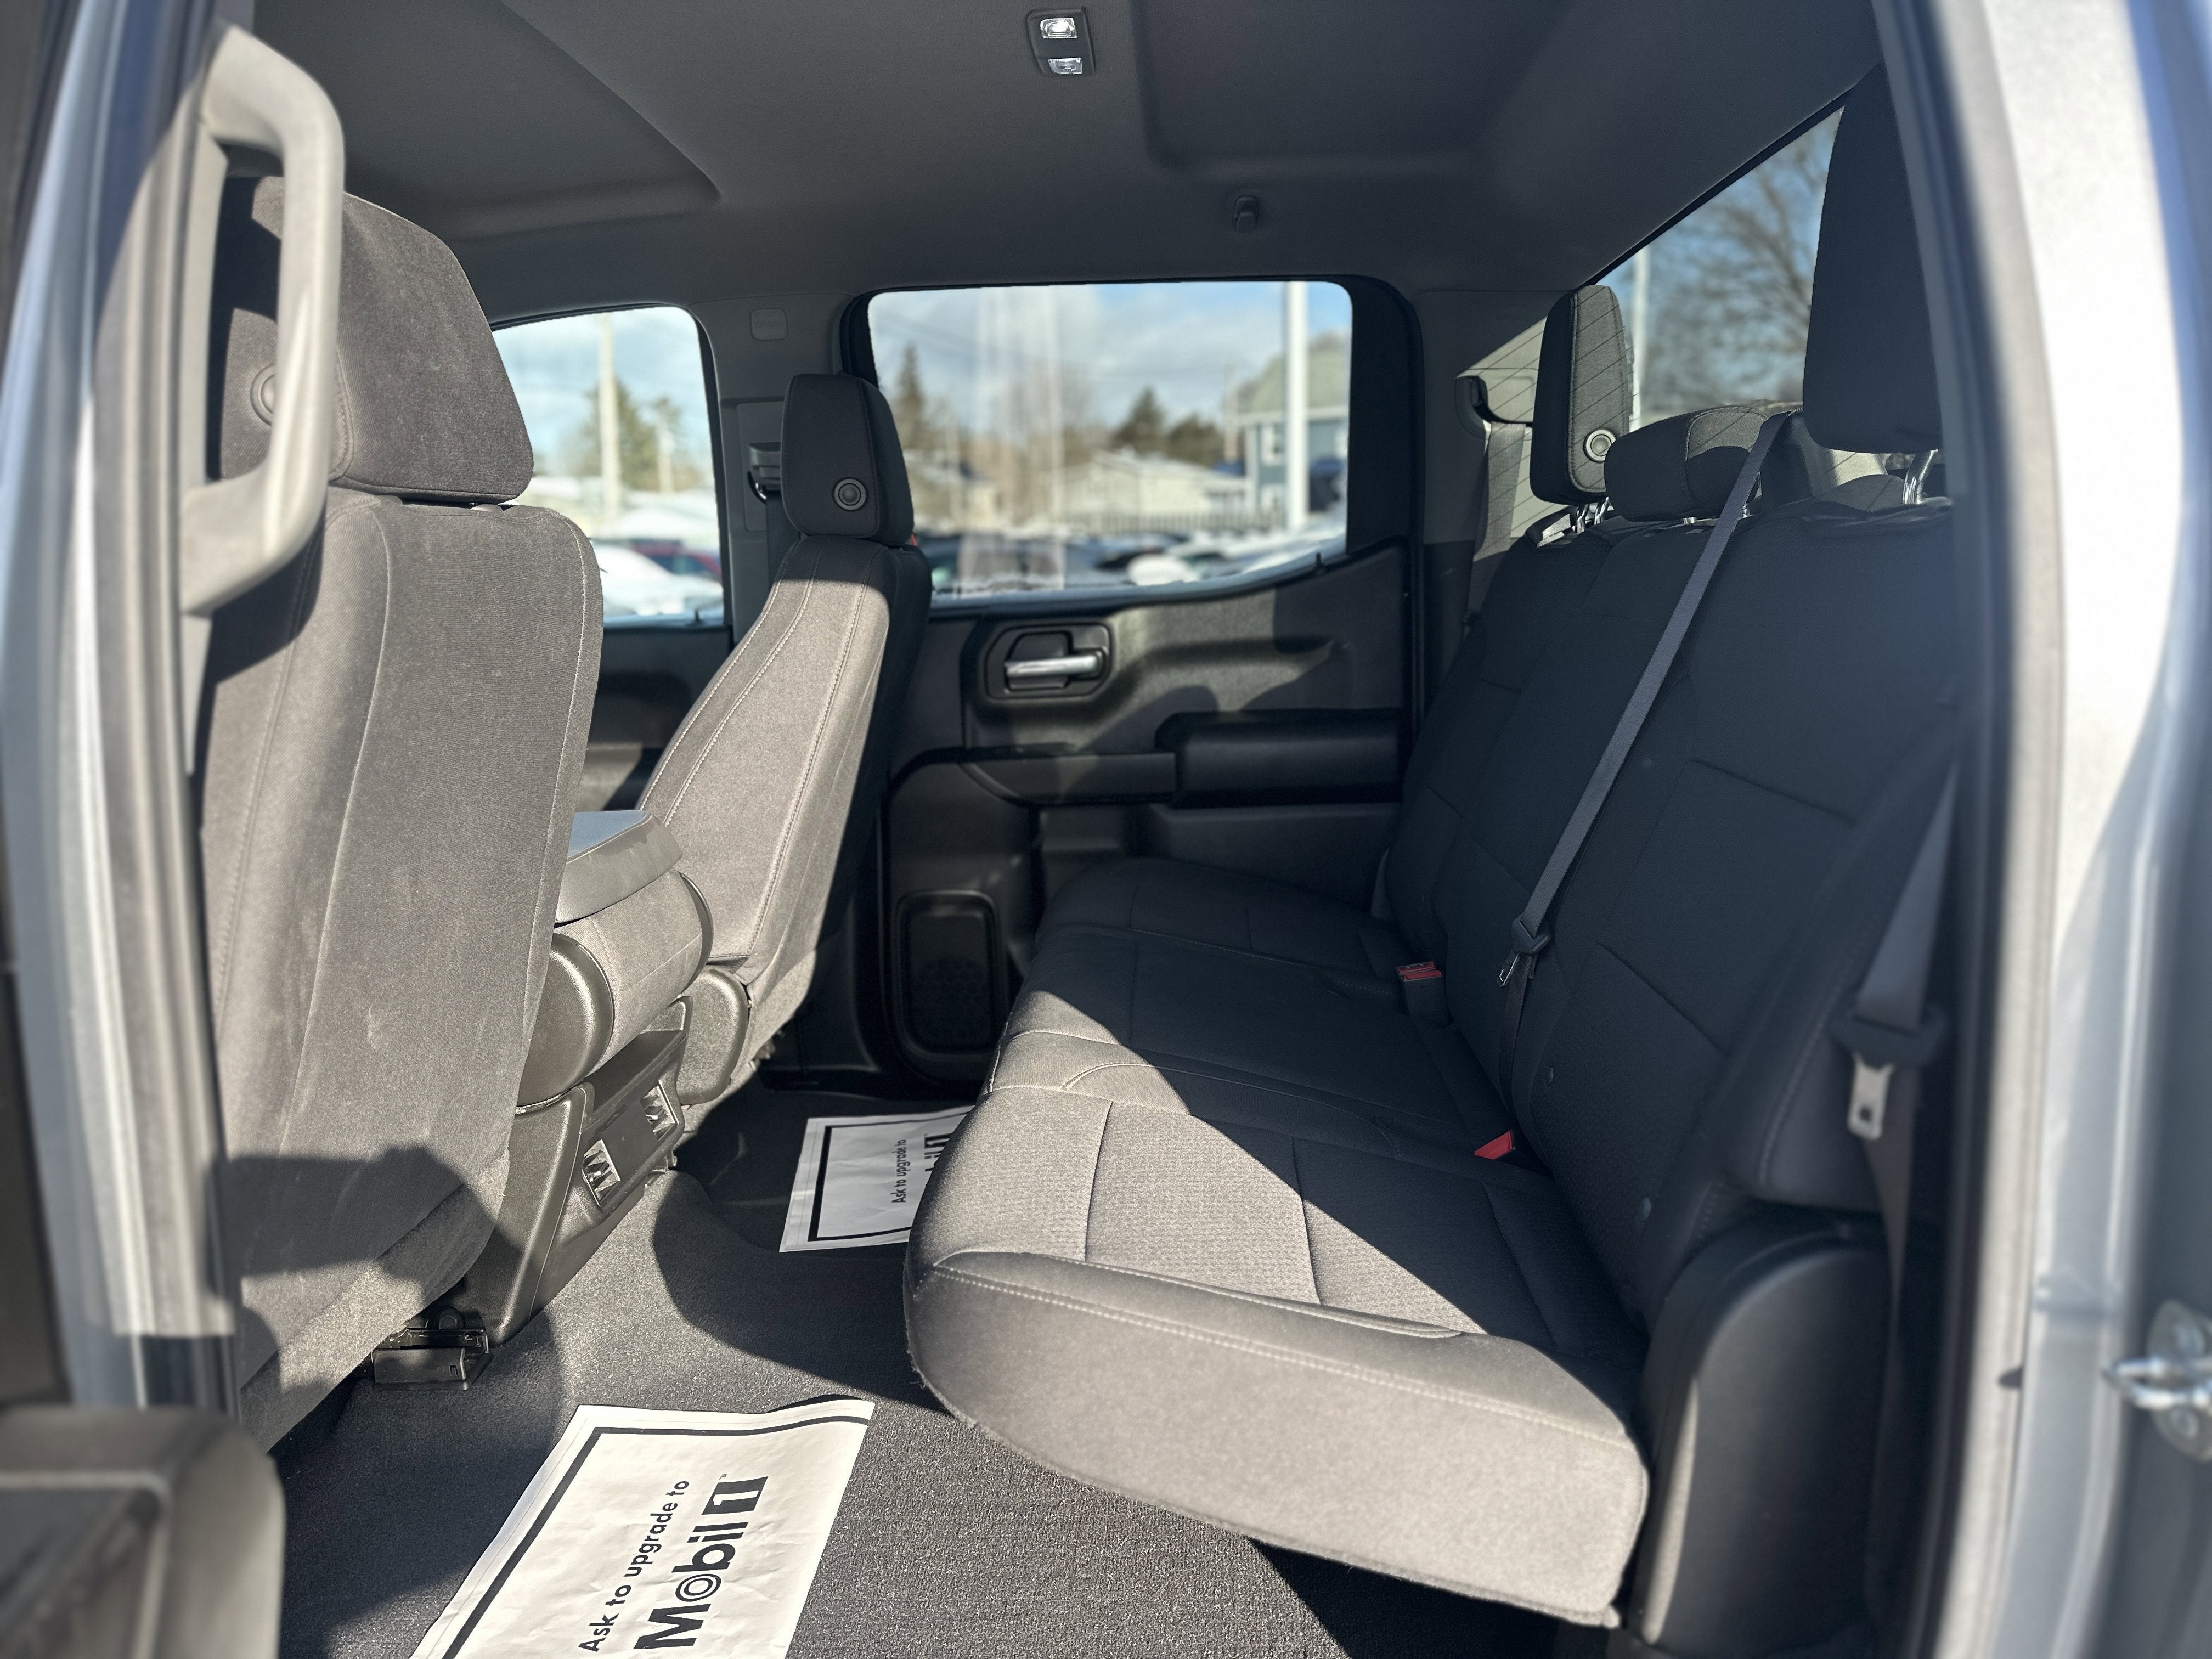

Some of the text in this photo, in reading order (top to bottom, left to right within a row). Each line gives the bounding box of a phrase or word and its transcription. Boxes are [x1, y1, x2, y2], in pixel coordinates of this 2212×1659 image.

[891, 1147, 911, 1177] upgrade
[890, 1188, 906, 1203] Ask
[894, 1179, 907, 1187] to
[578, 1481, 690, 1652] Ask to upgrade to
[633, 1521, 749, 1649] Mobil
